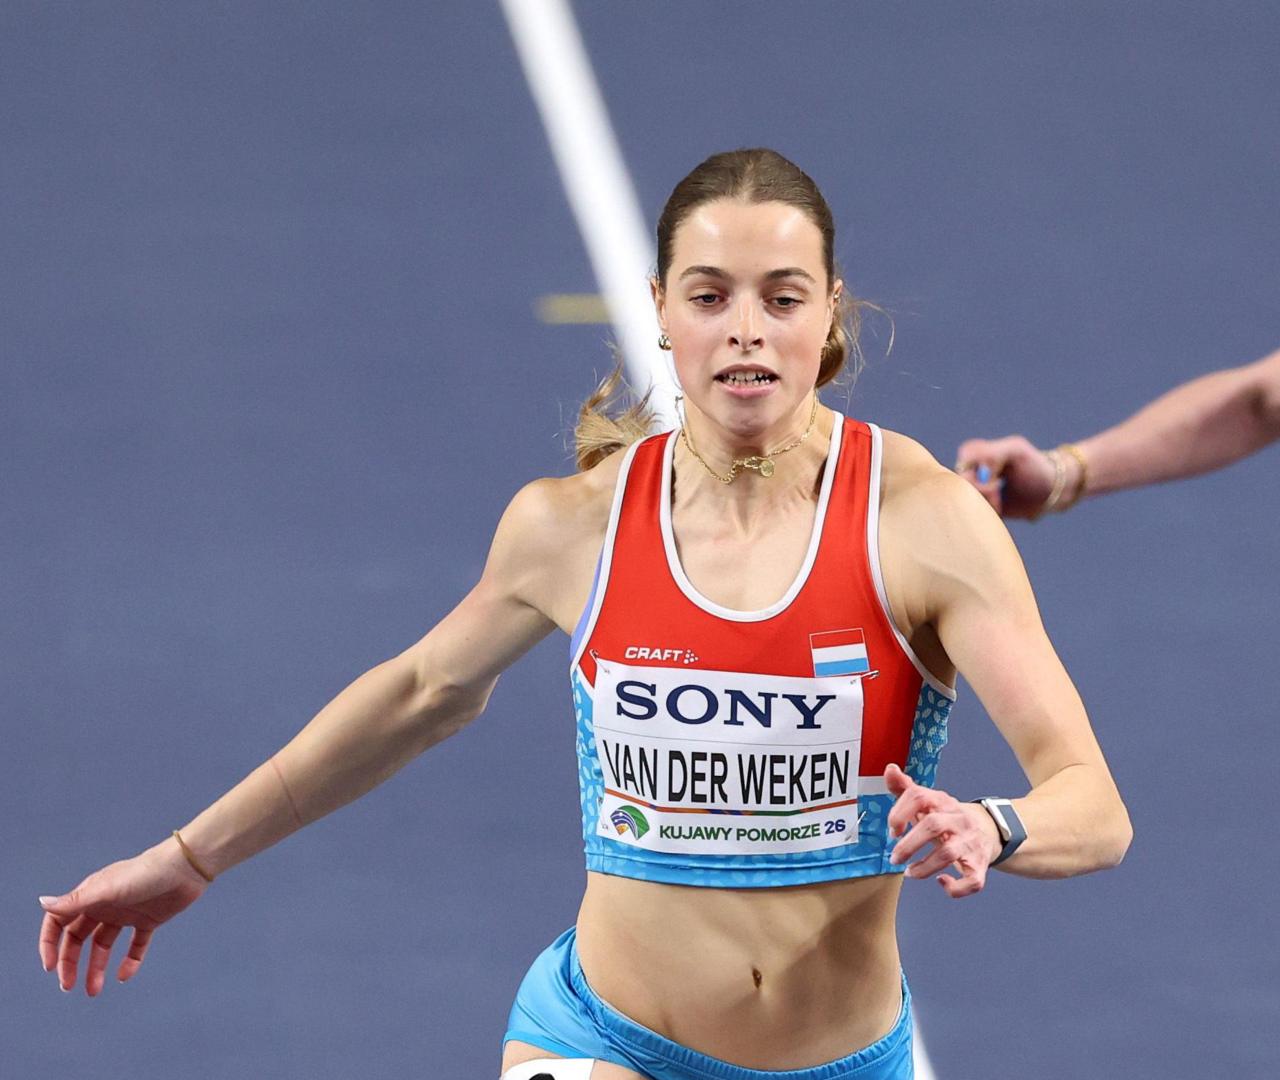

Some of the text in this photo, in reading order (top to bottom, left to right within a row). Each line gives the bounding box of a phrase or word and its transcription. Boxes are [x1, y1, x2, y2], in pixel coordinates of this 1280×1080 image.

[624, 646, 684, 662] CRAFT
[615, 680, 837, 730] SONY
[602, 739, 850, 805] VAN DER WEKEN
[659, 818, 847, 842] KUJAWY POMORZE 26
